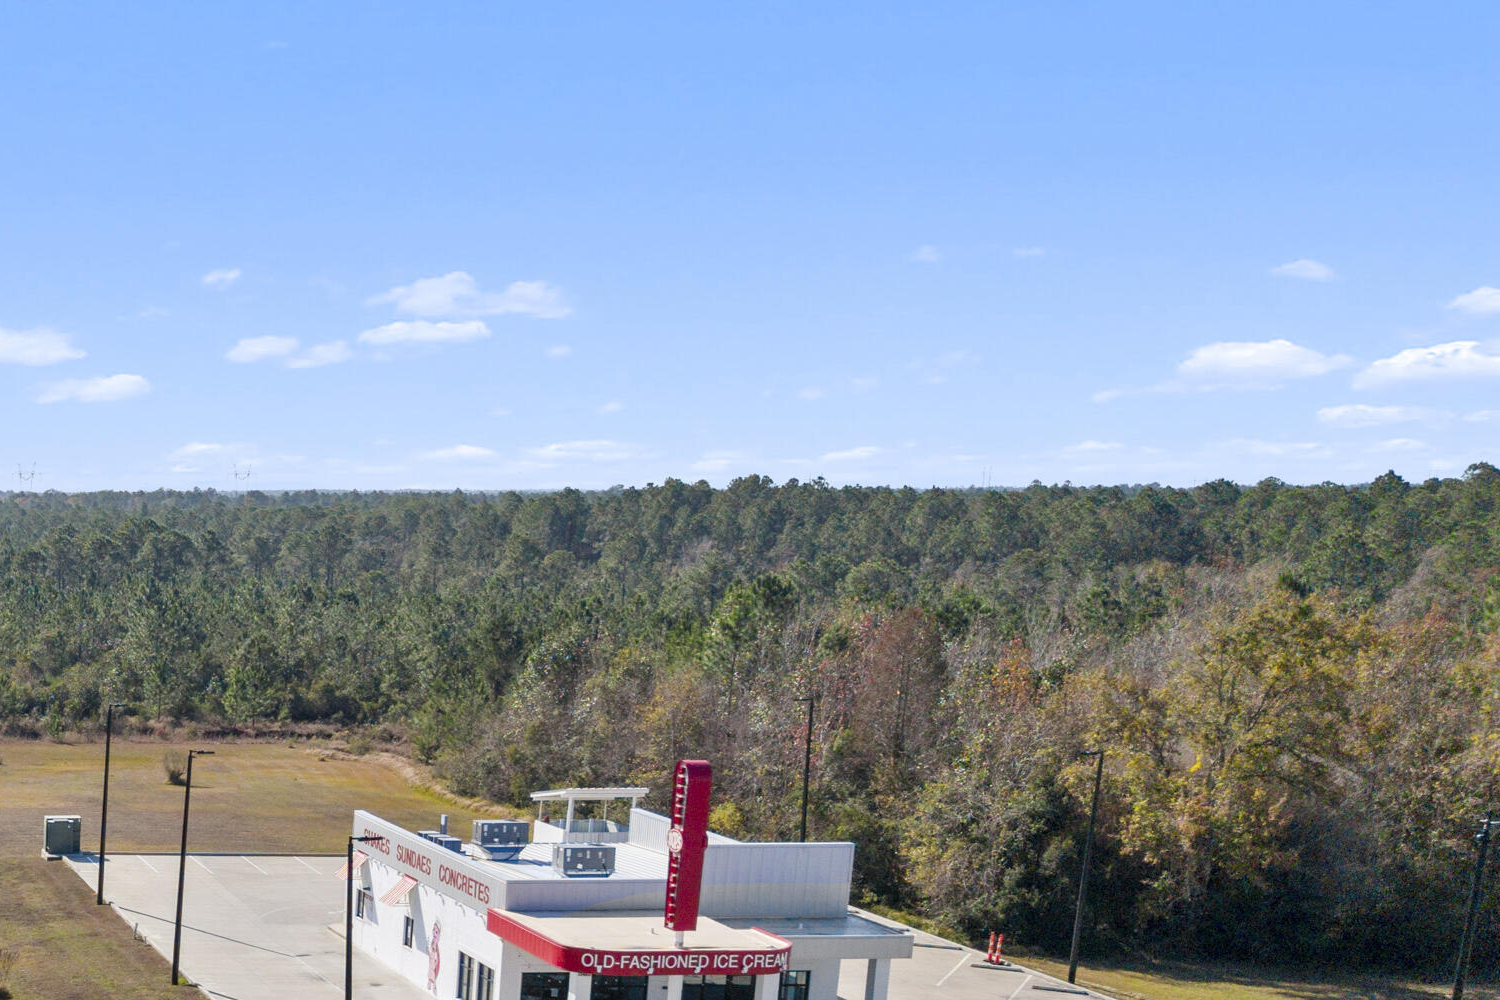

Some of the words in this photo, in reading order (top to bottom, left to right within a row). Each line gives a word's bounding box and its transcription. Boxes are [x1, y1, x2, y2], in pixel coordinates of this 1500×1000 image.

[364, 829, 390, 855] SHAKES
[396, 844, 431, 875] SUNDAES
[439, 864, 490, 904] CONCRETES
[581, 953, 709, 969] OLD-FASHIONED
[713, 955, 738, 968] ICE
